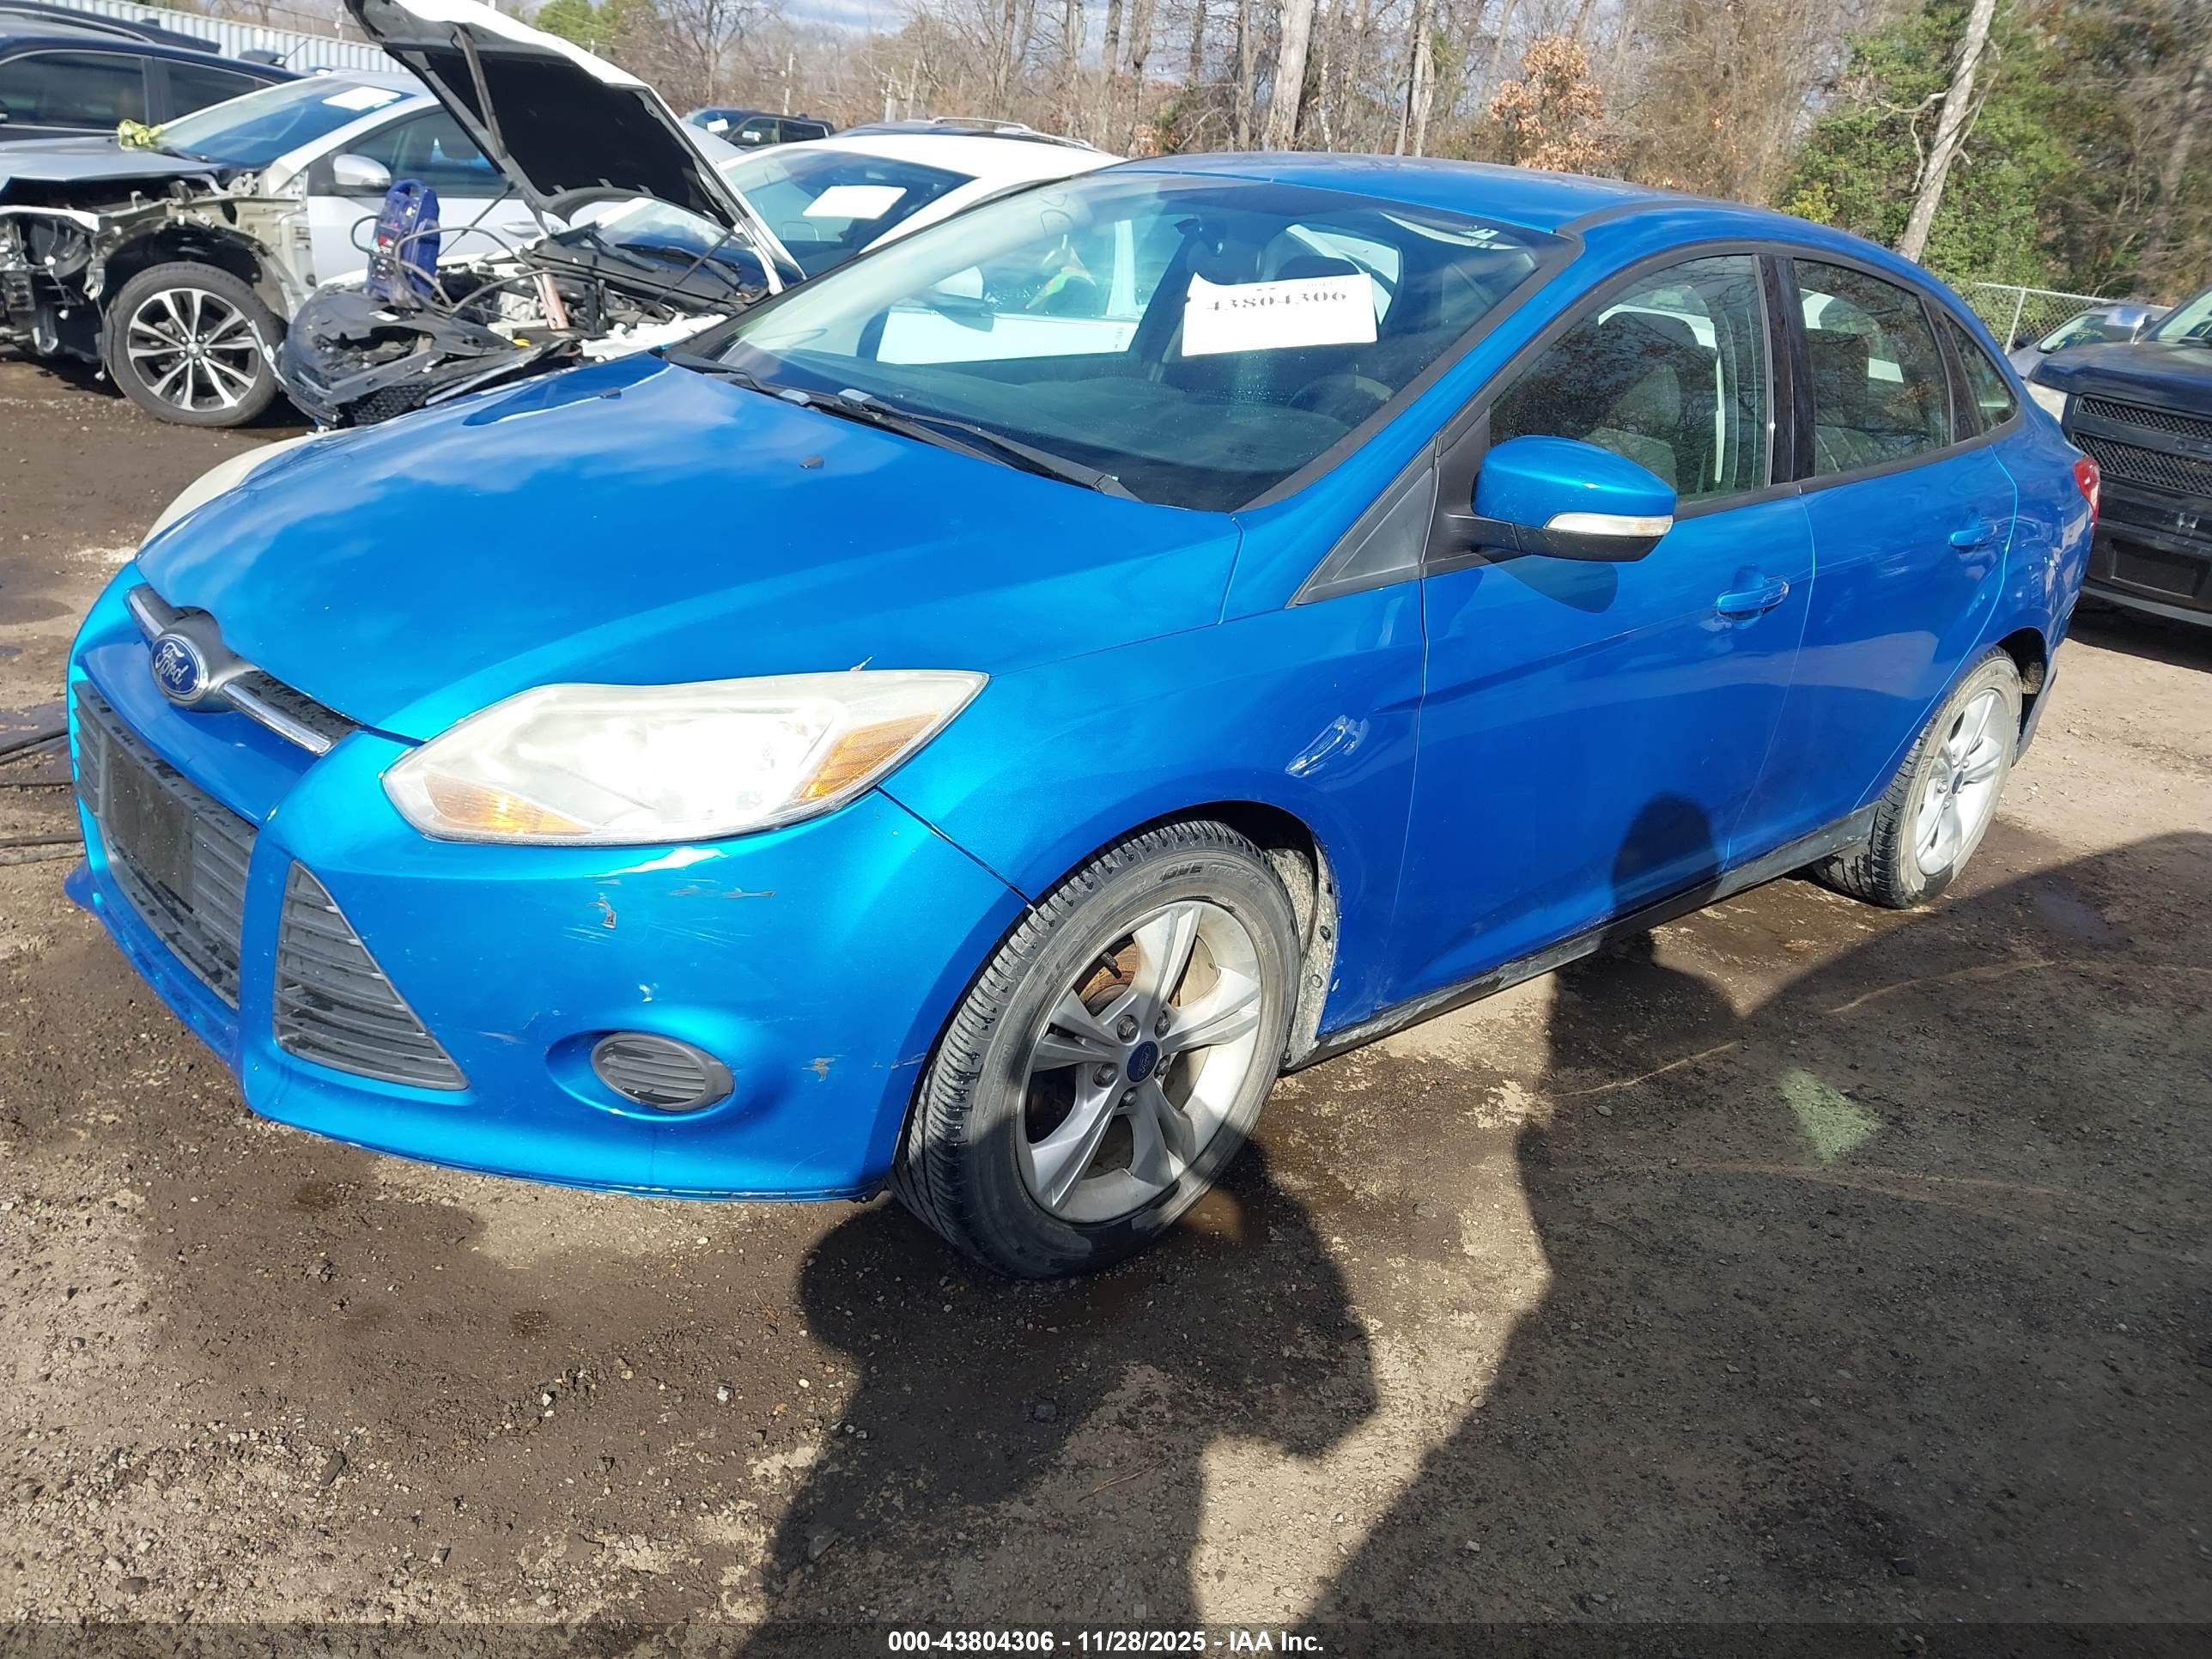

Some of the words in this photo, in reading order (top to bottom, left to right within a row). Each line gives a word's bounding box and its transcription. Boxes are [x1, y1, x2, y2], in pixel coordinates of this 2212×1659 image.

[1205, 290, 1347, 313] 43804306
[155, 641, 189, 685] Ford
[1139, 1044, 1152, 1074] Ford
